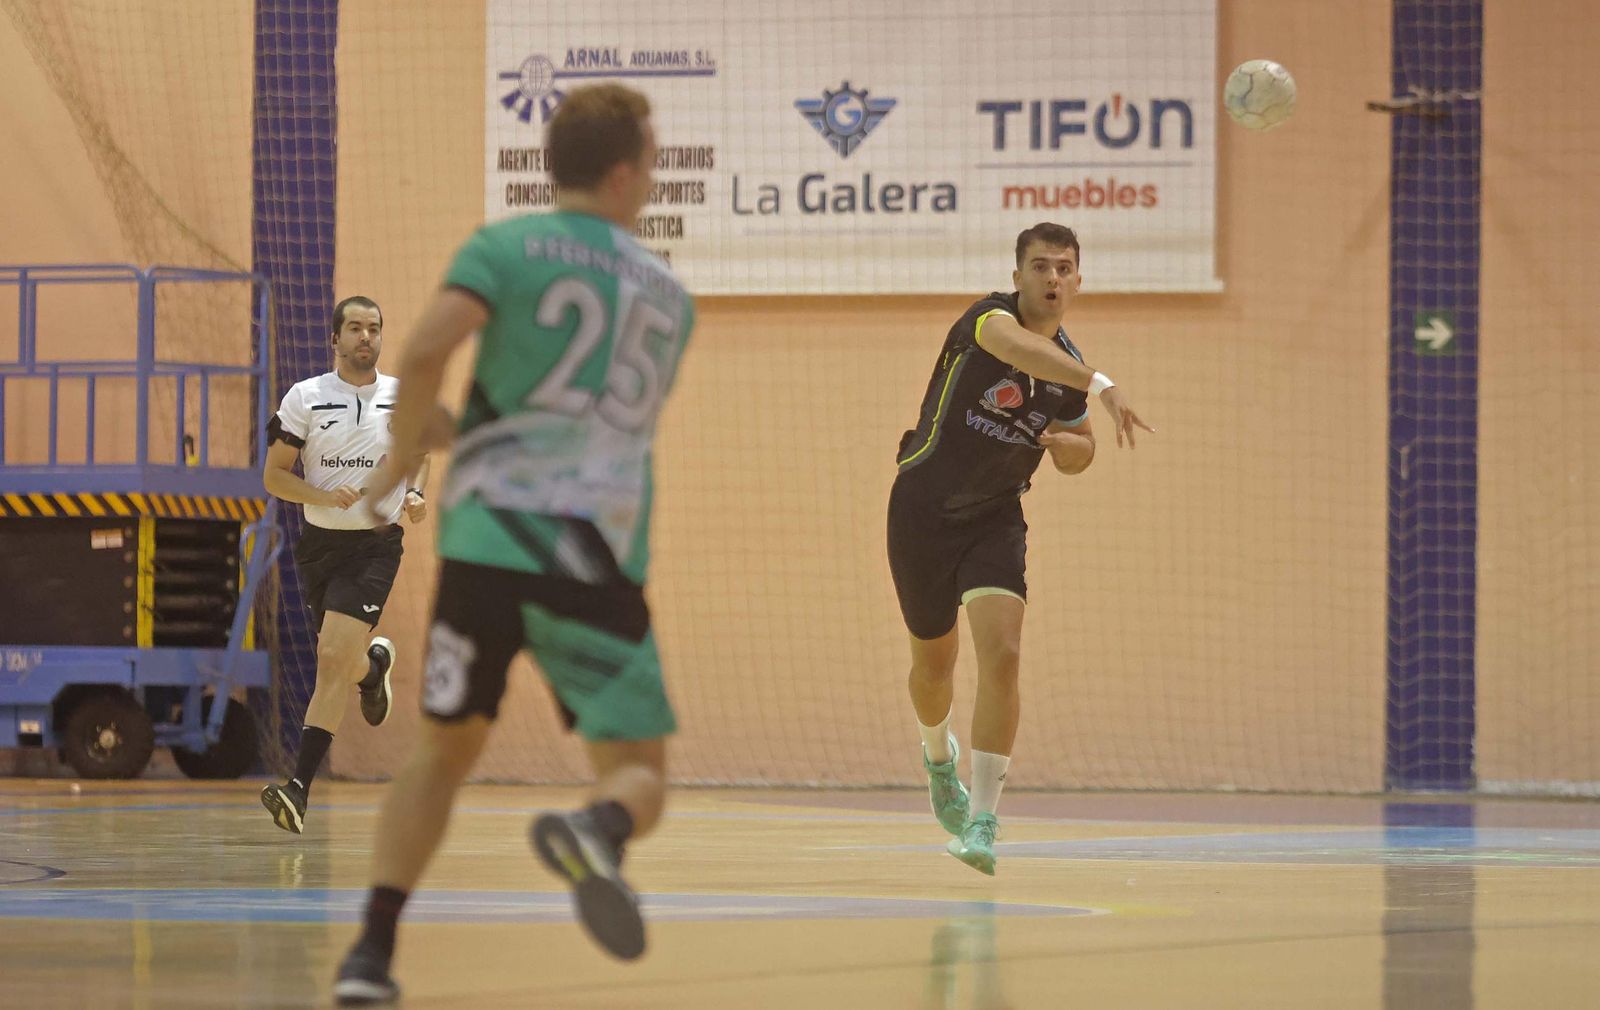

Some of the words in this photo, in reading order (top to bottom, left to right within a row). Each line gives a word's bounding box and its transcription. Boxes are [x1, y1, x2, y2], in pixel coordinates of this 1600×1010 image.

[564, 48, 622, 67] ARNAL
[497, 149, 541, 172] AGENTE
[653, 146, 714, 170] SITARIOS
[505, 182, 560, 208] CONSIGN
[647, 180, 705, 205] SPORTES
[731, 174, 780, 215] La
[797, 172, 958, 214] Galera
[1001, 177, 1159, 210] muebles
[635, 215, 684, 240] GISTICA
[526, 275, 675, 431] 25
[320, 455, 374, 468] helvetia
